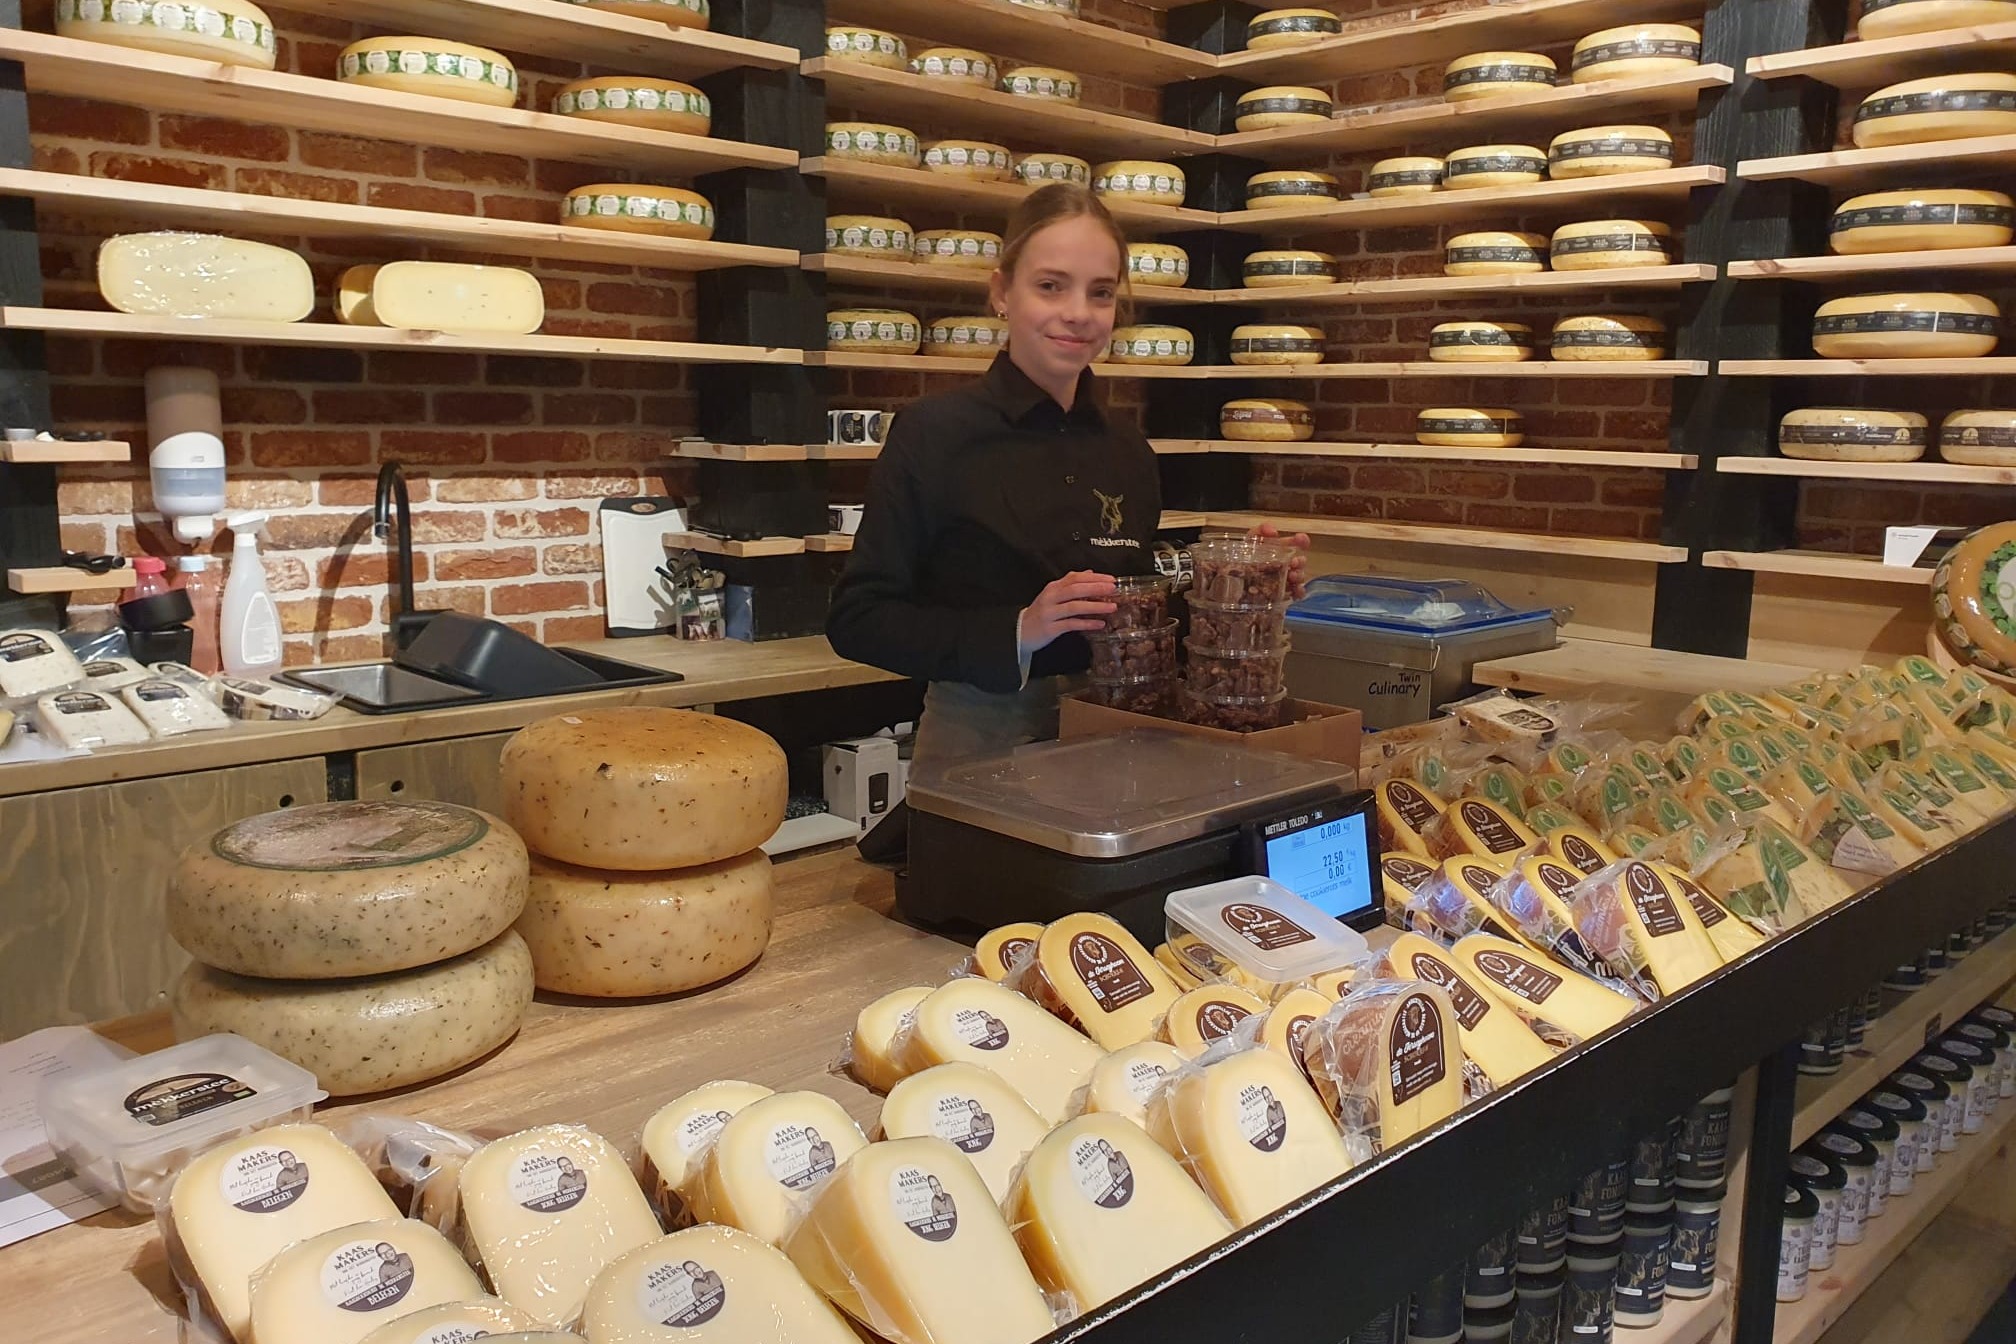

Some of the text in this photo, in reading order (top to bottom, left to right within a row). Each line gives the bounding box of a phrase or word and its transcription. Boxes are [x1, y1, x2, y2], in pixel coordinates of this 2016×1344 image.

[1398, 672, 1421, 682] Twin
[1368, 681, 1421, 698] Culinary
[1265, 821, 1288, 836] METTLER
[1288, 815, 1309, 829] TOLEDO
[1320, 823, 1341, 840] 0,000
[1322, 850, 1343, 868] 22,50
[1328, 864, 1345, 880] 0,00
[1131, 1063, 1148, 1072] KAAS
[1132, 1067, 1155, 1078] MAKERS
[1240, 1084, 1255, 1097] KAAS
[1240, 1089, 1262, 1105] MAKERS
[938, 1101, 967, 1111] MAKERS
[940, 1096, 960, 1105] KAAS
[686, 1115, 717, 1134] MAKERS
[687, 1113, 708, 1128] KAAS
[1707, 1118, 1727, 1134] KAA
[774, 1130, 805, 1147] MAKERS
[775, 1125, 796, 1138] KAAS
[241, 1150, 268, 1163] KAAS
[1076, 1141, 1091, 1157] KAAS
[1077, 1144, 1098, 1165] MAKERS
[237, 1153, 278, 1172] MAKERS
[521, 1159, 556, 1173] MAKERS
[523, 1155, 547, 1166] KAAS
[898, 1175, 928, 1187] MAKERS
[899, 1168, 919, 1179] KAAS
[334, 1247, 375, 1271] MAKERS
[336, 1244, 364, 1261] KAAS
[648, 1264, 672, 1280] KAAS
[648, 1266, 682, 1289] MAKERS
[432, 1328, 462, 1344] KAAS
